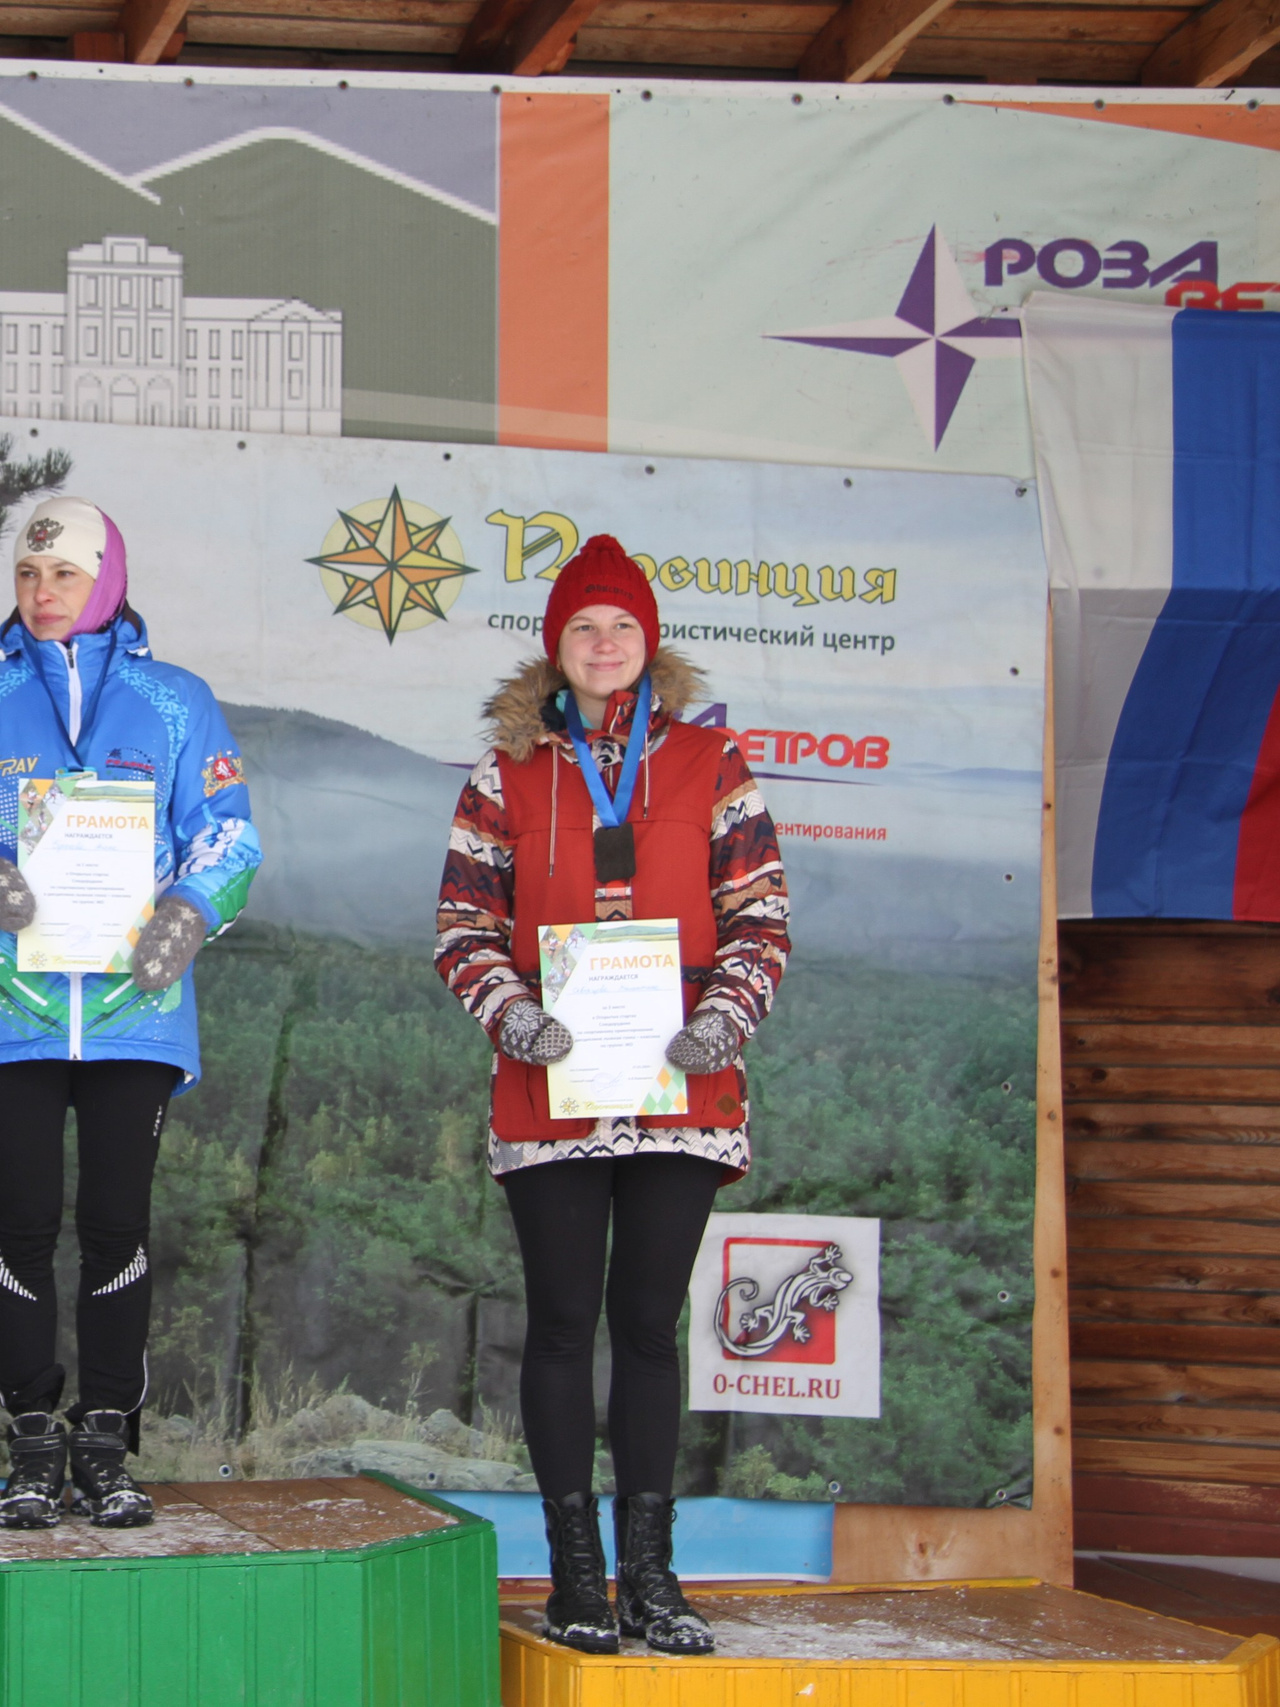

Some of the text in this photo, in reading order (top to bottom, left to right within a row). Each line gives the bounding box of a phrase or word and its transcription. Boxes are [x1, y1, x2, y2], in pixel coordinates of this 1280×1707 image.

[984, 237, 1218, 289] РОЗА
[485, 508, 897, 607] Пвинция
[822, 631, 896, 655] центр
[718, 727, 890, 769] ЕТРОВ
[66, 814, 149, 830] ГРАМОТА
[774, 822, 887, 842] ентирования
[590, 954, 675, 971] ГРАМОТА
